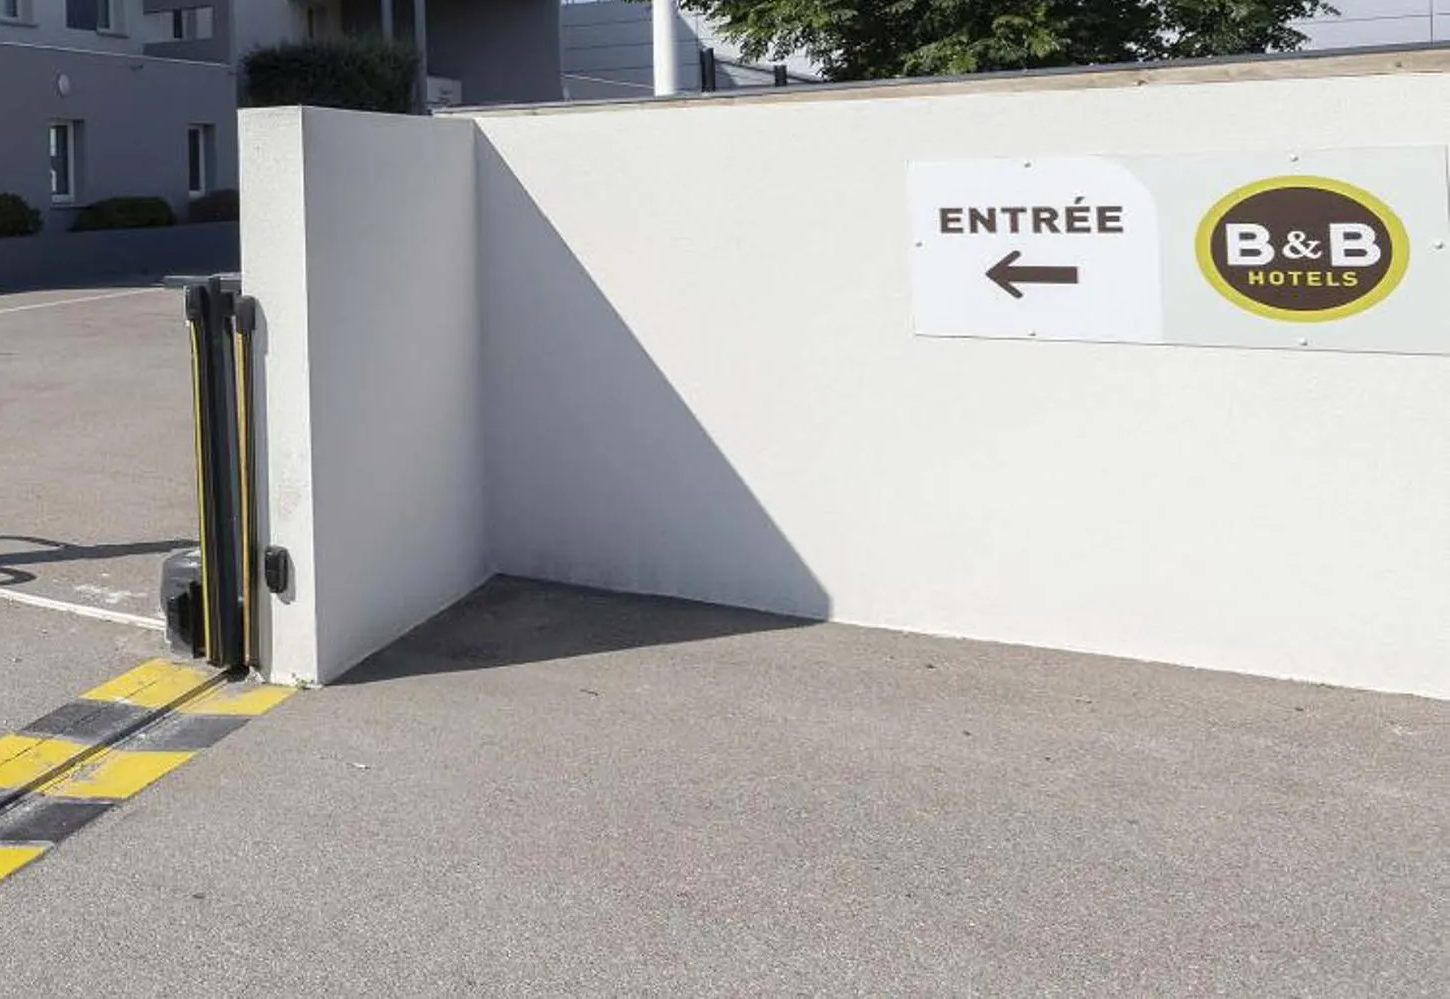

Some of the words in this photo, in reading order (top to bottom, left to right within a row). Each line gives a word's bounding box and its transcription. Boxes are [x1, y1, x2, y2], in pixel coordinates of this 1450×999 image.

[939, 196, 1124, 234] ENTRÉE
[1225, 222, 1382, 267] B&B
[1248, 270, 1359, 287] HOTELS
